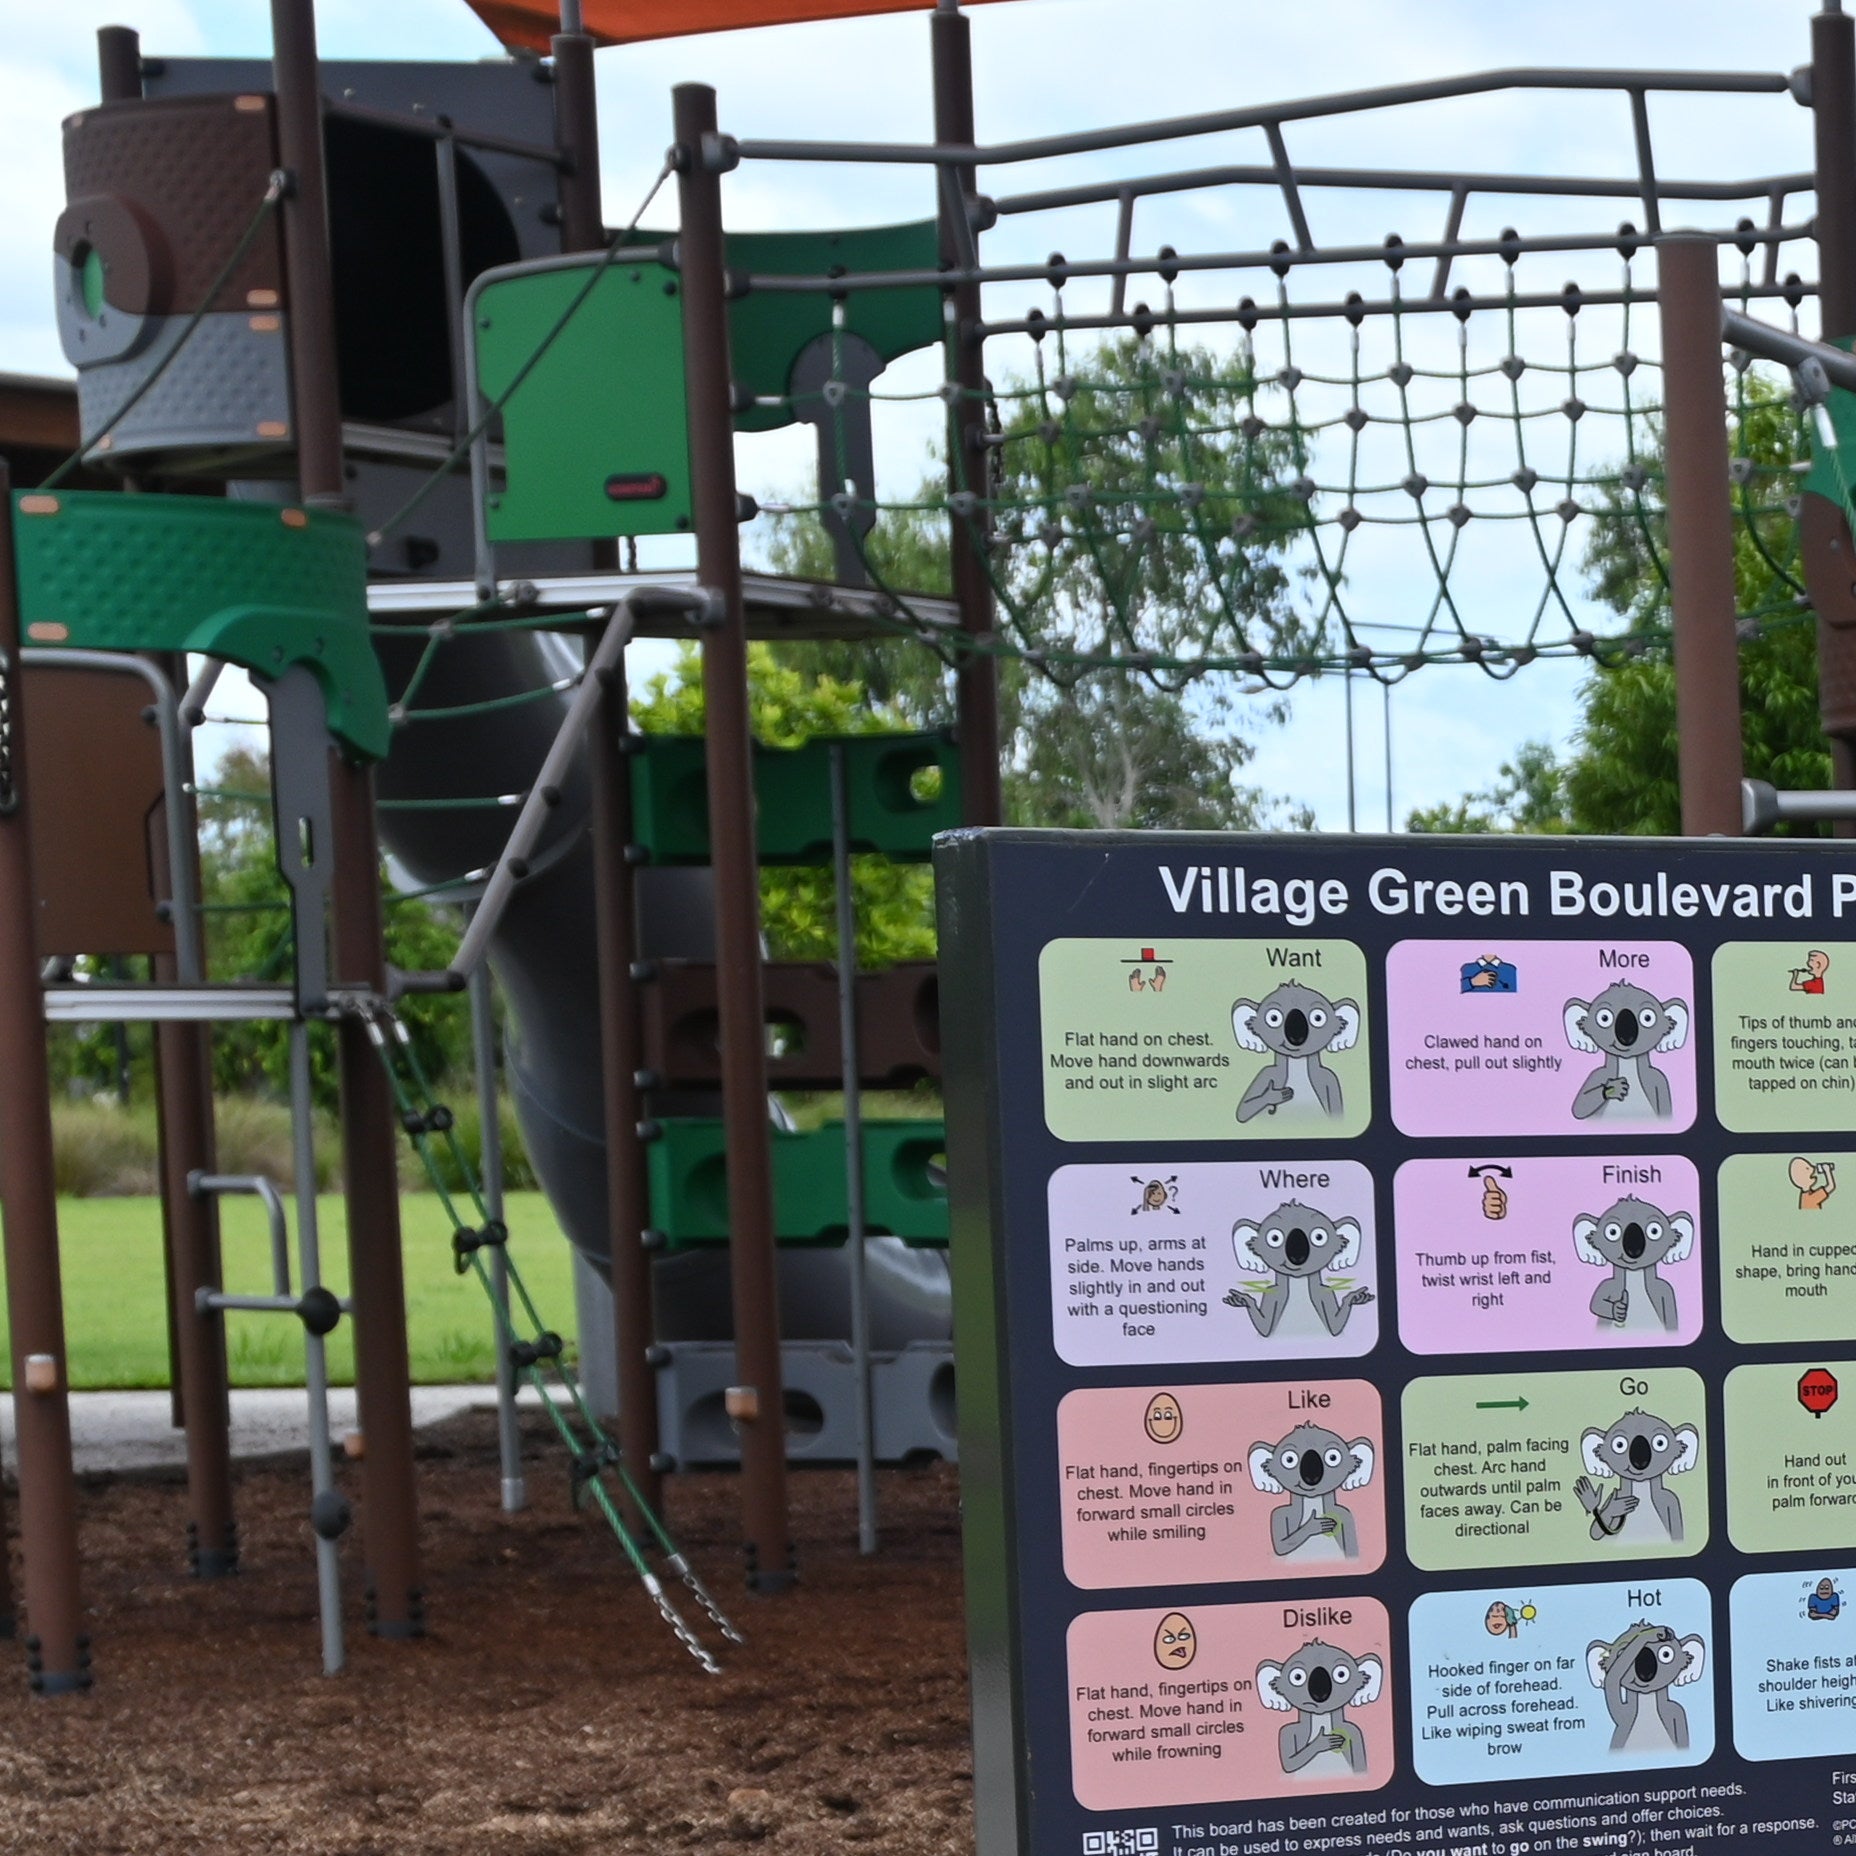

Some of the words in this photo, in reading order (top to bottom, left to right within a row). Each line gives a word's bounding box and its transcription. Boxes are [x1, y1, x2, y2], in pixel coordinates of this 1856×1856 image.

[1158, 865, 1349, 926] Village
[1368, 867, 1529, 916] Green
[1549, 870, 1812, 918] Boulevard
[1266, 947, 1322, 967] Want
[1599, 948, 1650, 968] More
[1065, 1031, 1095, 1047] Flat
[1099, 1031, 1138, 1046] hand
[1143, 1034, 1162, 1046] on
[1167, 1031, 1214, 1046] chest.
[1405, 1055, 1449, 1071] chest,
[1454, 1055, 1480, 1073] pull
[1484, 1055, 1508, 1069] out
[1512, 1055, 1562, 1072] slightly
[1259, 1169, 1330, 1189] Where
[1602, 1164, 1661, 1184] Finish
[1414, 1252, 1467, 1266] Thumb
[1471, 1254, 1489, 1268] up
[1493, 1250, 1526, 1264] from
[1530, 1249, 1556, 1265] fist,
[1751, 1243, 1788, 1258] Hand
[1792, 1243, 1804, 1257] in
[1619, 1376, 1649, 1396] Go
[1802, 1385, 1833, 1397] STOP
[1287, 1389, 1331, 1409] Like
[1784, 1453, 1821, 1468] Hand
[1824, 1452, 1847, 1466] out
[1767, 1475, 1779, 1489] in
[1783, 1473, 1815, 1488] front
[1818, 1471, 1832, 1487] of
[1772, 1493, 1805, 1512] palm
[1627, 1588, 1662, 1608] Hot
[1283, 1606, 1352, 1628] Dislike
[1766, 1657, 1810, 1673] Shake
[1813, 1655, 1841, 1669] fists
[1758, 1676, 1817, 1693] shoulder
[1766, 1697, 1794, 1712] Like
[1171, 1823, 1205, 1839] This
[1209, 1819, 1253, 1837] board
[1257, 1819, 1285, 1833] has
[1289, 1816, 1326, 1830] been
[1331, 1809, 1387, 1827] created
[1390, 1807, 1411, 1822] for
[1414, 1806, 1455, 1820] those
[1459, 1802, 1490, 1817] who
[1493, 1800, 1529, 1814] have
[1532, 1790, 1640, 1811] communication
[1644, 1785, 1697, 1804] support
[1700, 1781, 1747, 1797] needs.
